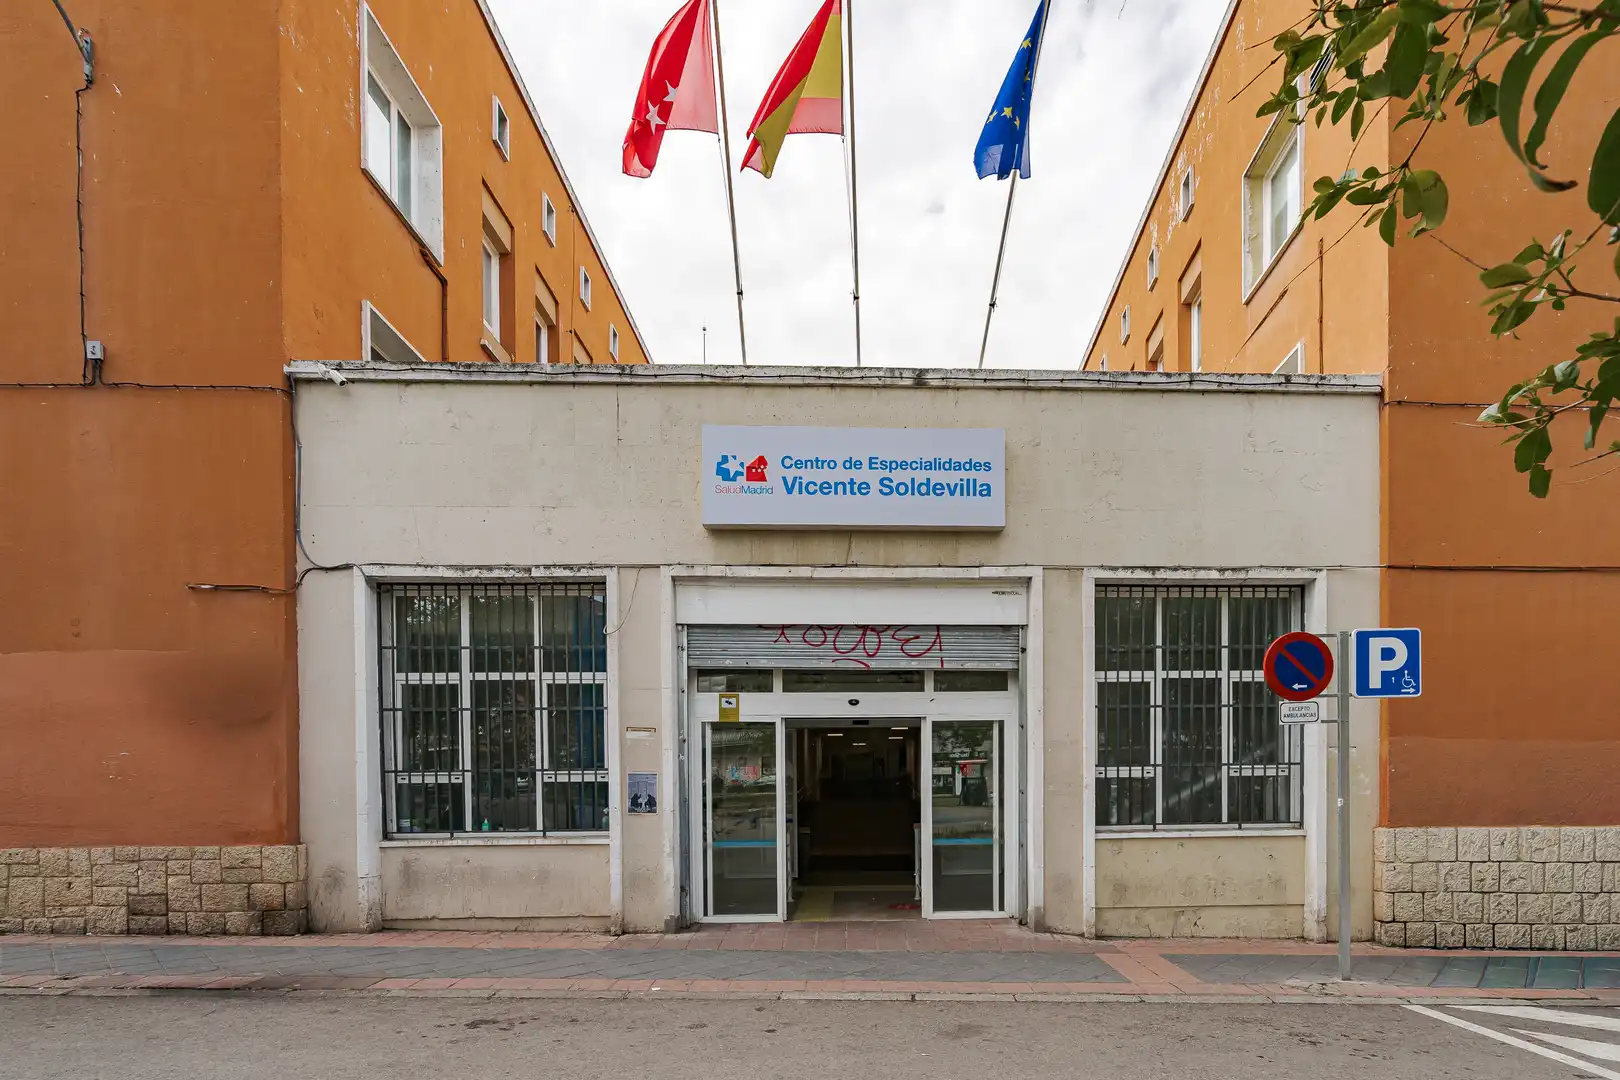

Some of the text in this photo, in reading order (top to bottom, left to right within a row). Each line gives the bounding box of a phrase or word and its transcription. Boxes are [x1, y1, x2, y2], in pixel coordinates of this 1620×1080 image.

[781, 455, 992, 474] Centro de Especialidades
[714, 484, 774, 495] SaludMadrid
[781, 476, 992, 498] Vicente Soldevilla
[1369, 637, 1408, 689] P
